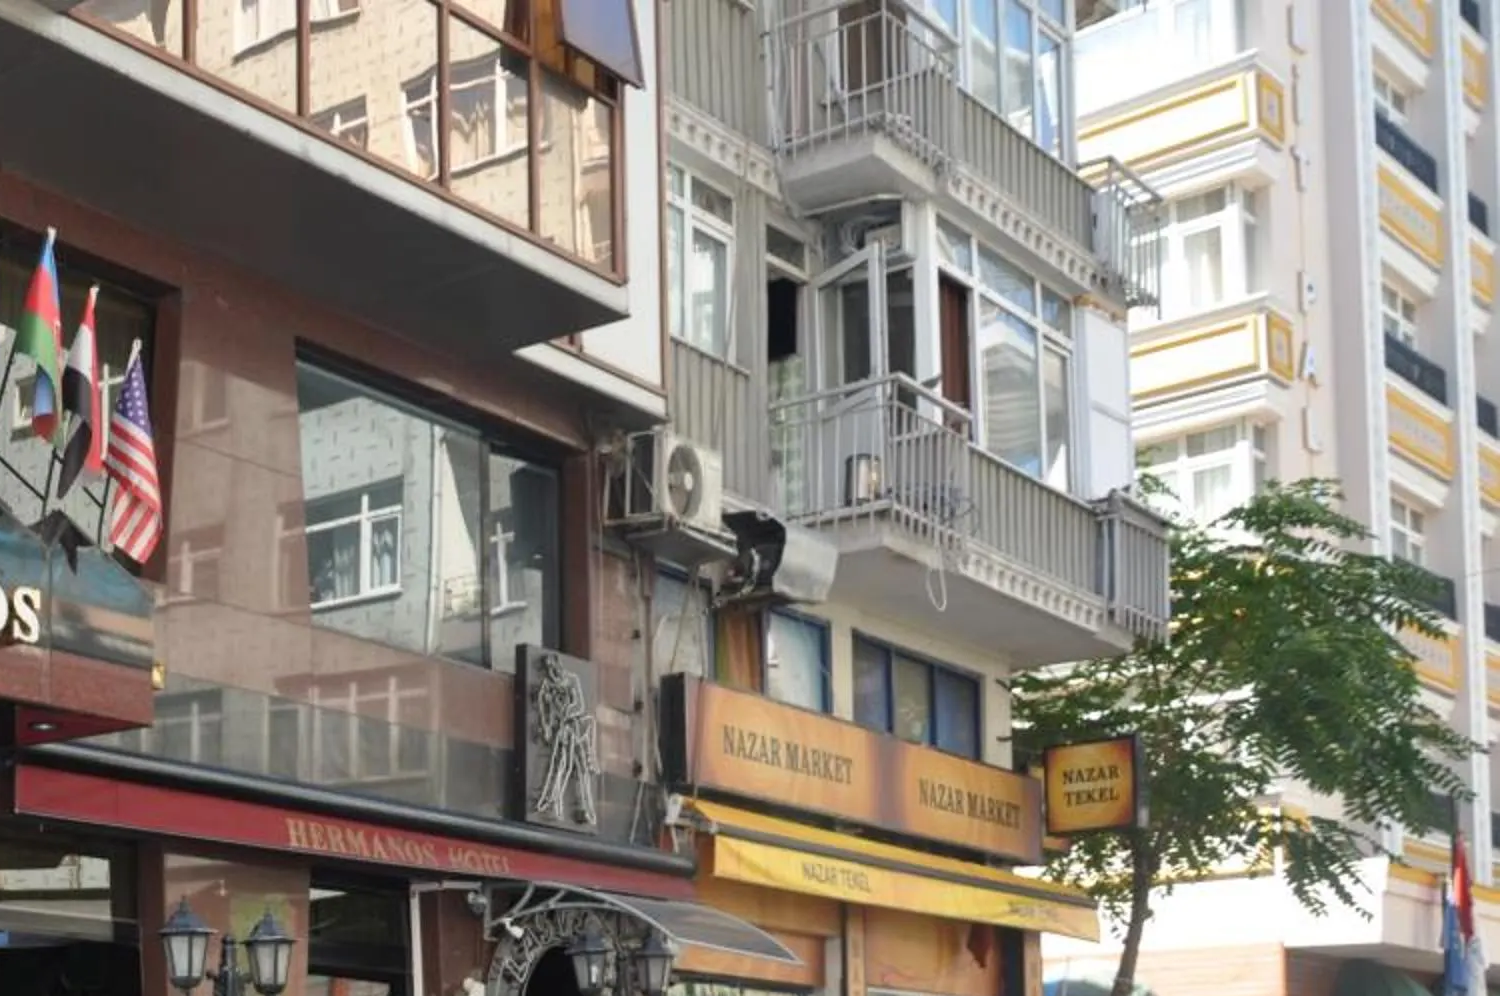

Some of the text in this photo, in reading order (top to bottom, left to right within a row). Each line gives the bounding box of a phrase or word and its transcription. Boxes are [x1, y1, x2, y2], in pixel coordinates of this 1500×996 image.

[723, 724, 853, 785] NAZAR MARKET
[1062, 764, 1120, 785] NAZAR
[918, 777, 1021, 831] NAZAR MARKET
[1063, 787, 1121, 809] TEKEL
[285, 816, 511, 874] HERMANOS HOTEL
[802, 861, 838, 886] NAZAR
